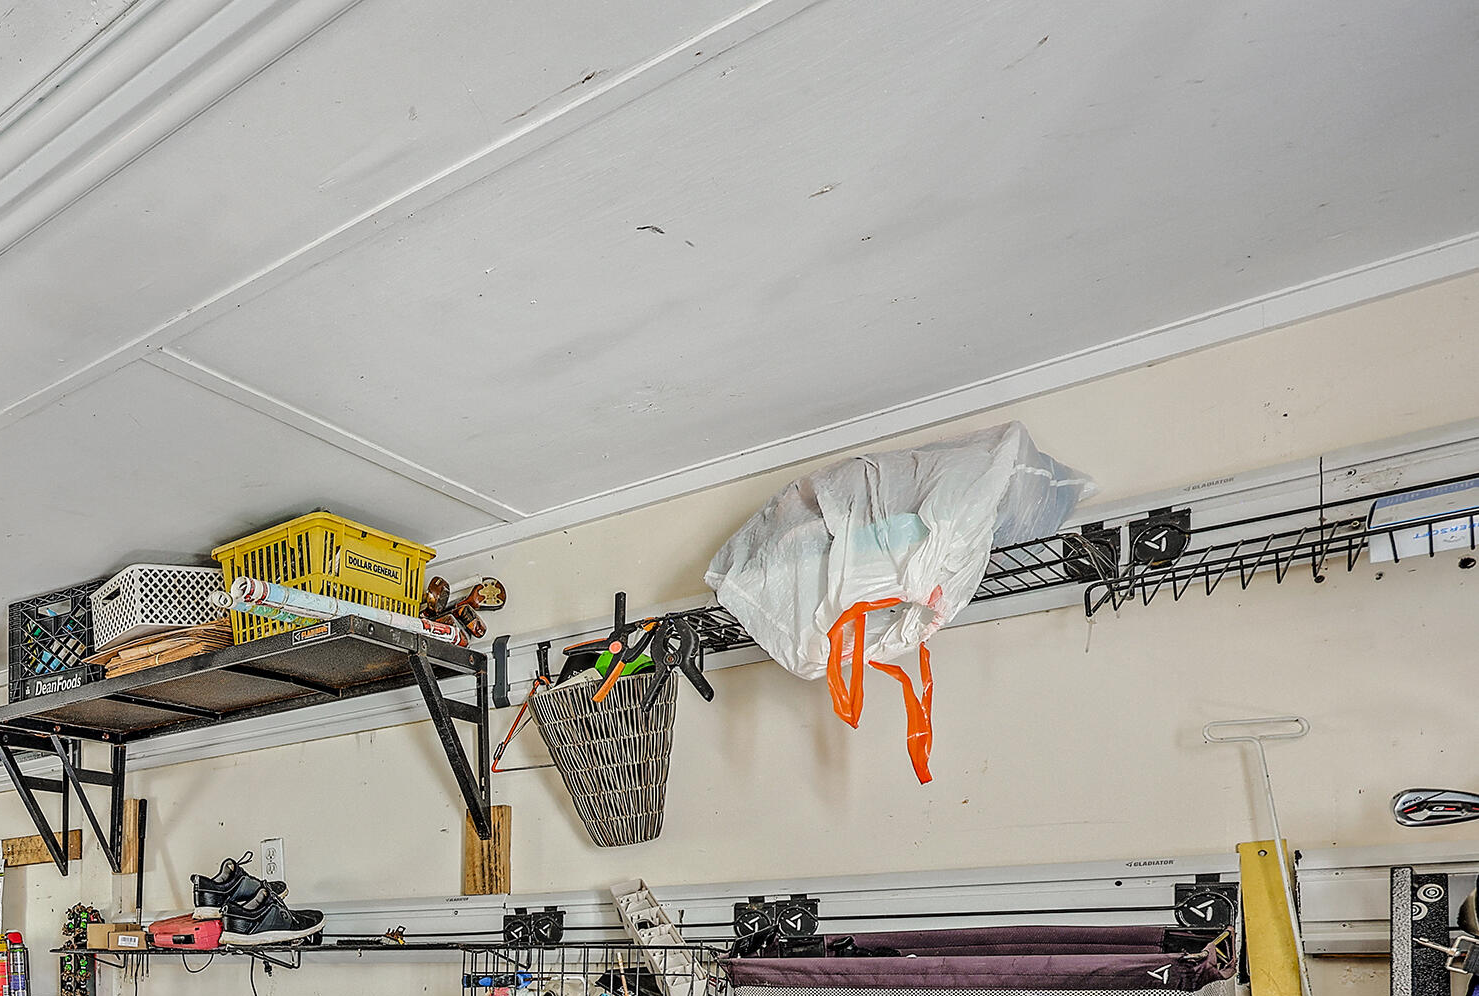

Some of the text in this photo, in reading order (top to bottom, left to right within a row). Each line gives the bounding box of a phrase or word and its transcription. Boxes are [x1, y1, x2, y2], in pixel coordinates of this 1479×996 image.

[348, 555, 399, 580] DOLLAR GENERAL
[34, 673, 82, 696] DeanFoods
[1133, 859, 1174, 867] GLADIATOR
